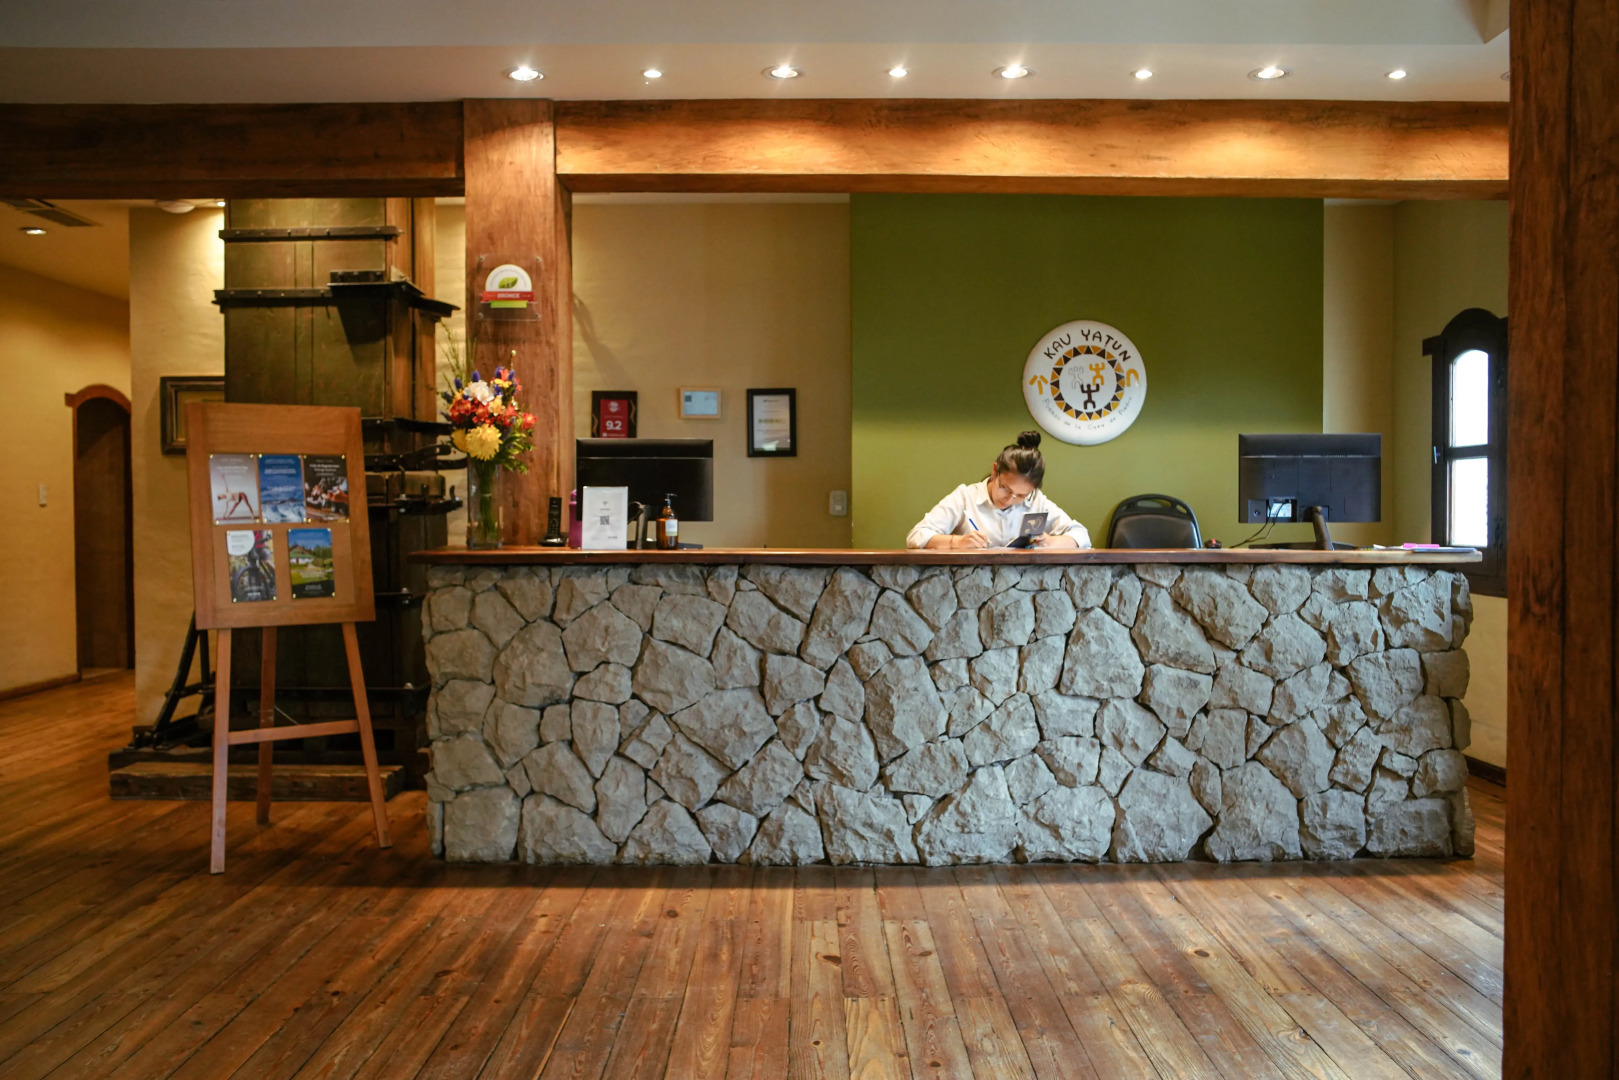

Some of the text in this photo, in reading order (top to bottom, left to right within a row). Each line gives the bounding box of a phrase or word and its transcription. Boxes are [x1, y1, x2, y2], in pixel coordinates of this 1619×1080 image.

[1043, 328, 1131, 362] KAU YATUN
[605, 420, 622, 431] 9.2
